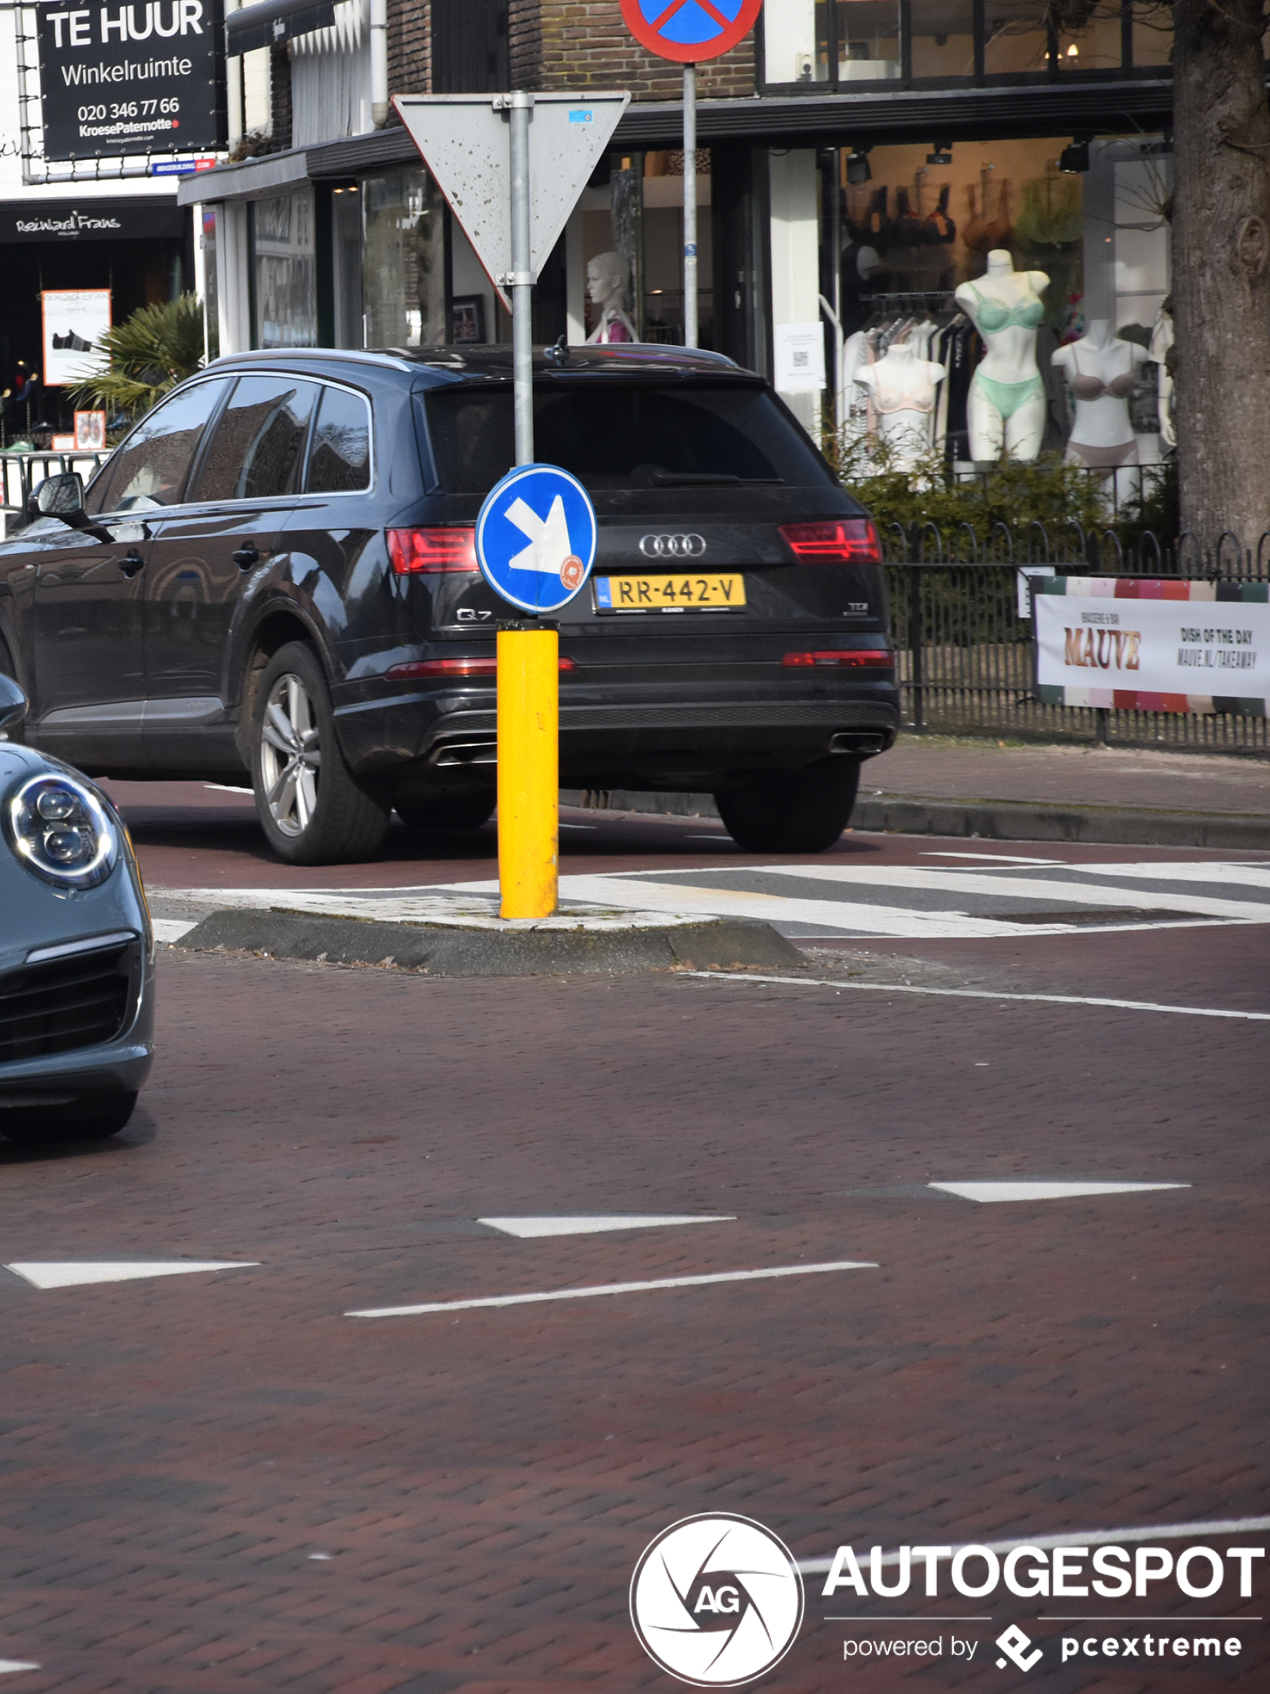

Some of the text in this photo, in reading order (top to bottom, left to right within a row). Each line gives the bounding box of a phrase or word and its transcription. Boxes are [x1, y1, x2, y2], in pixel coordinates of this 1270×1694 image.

[46, 0, 203, 48] TE HUUR
[61, 56, 192, 86] Winkelruimte
[78, 97, 179, 121] 020 346 77 66
[79, 118, 172, 137] KroesePaternotte
[619, 579, 733, 603] RR-442-V
[457, 608, 492, 620] Q7
[1064, 627, 1141, 670] MAUVE
[1181, 628, 1252, 645] DISH OF THE DAY
